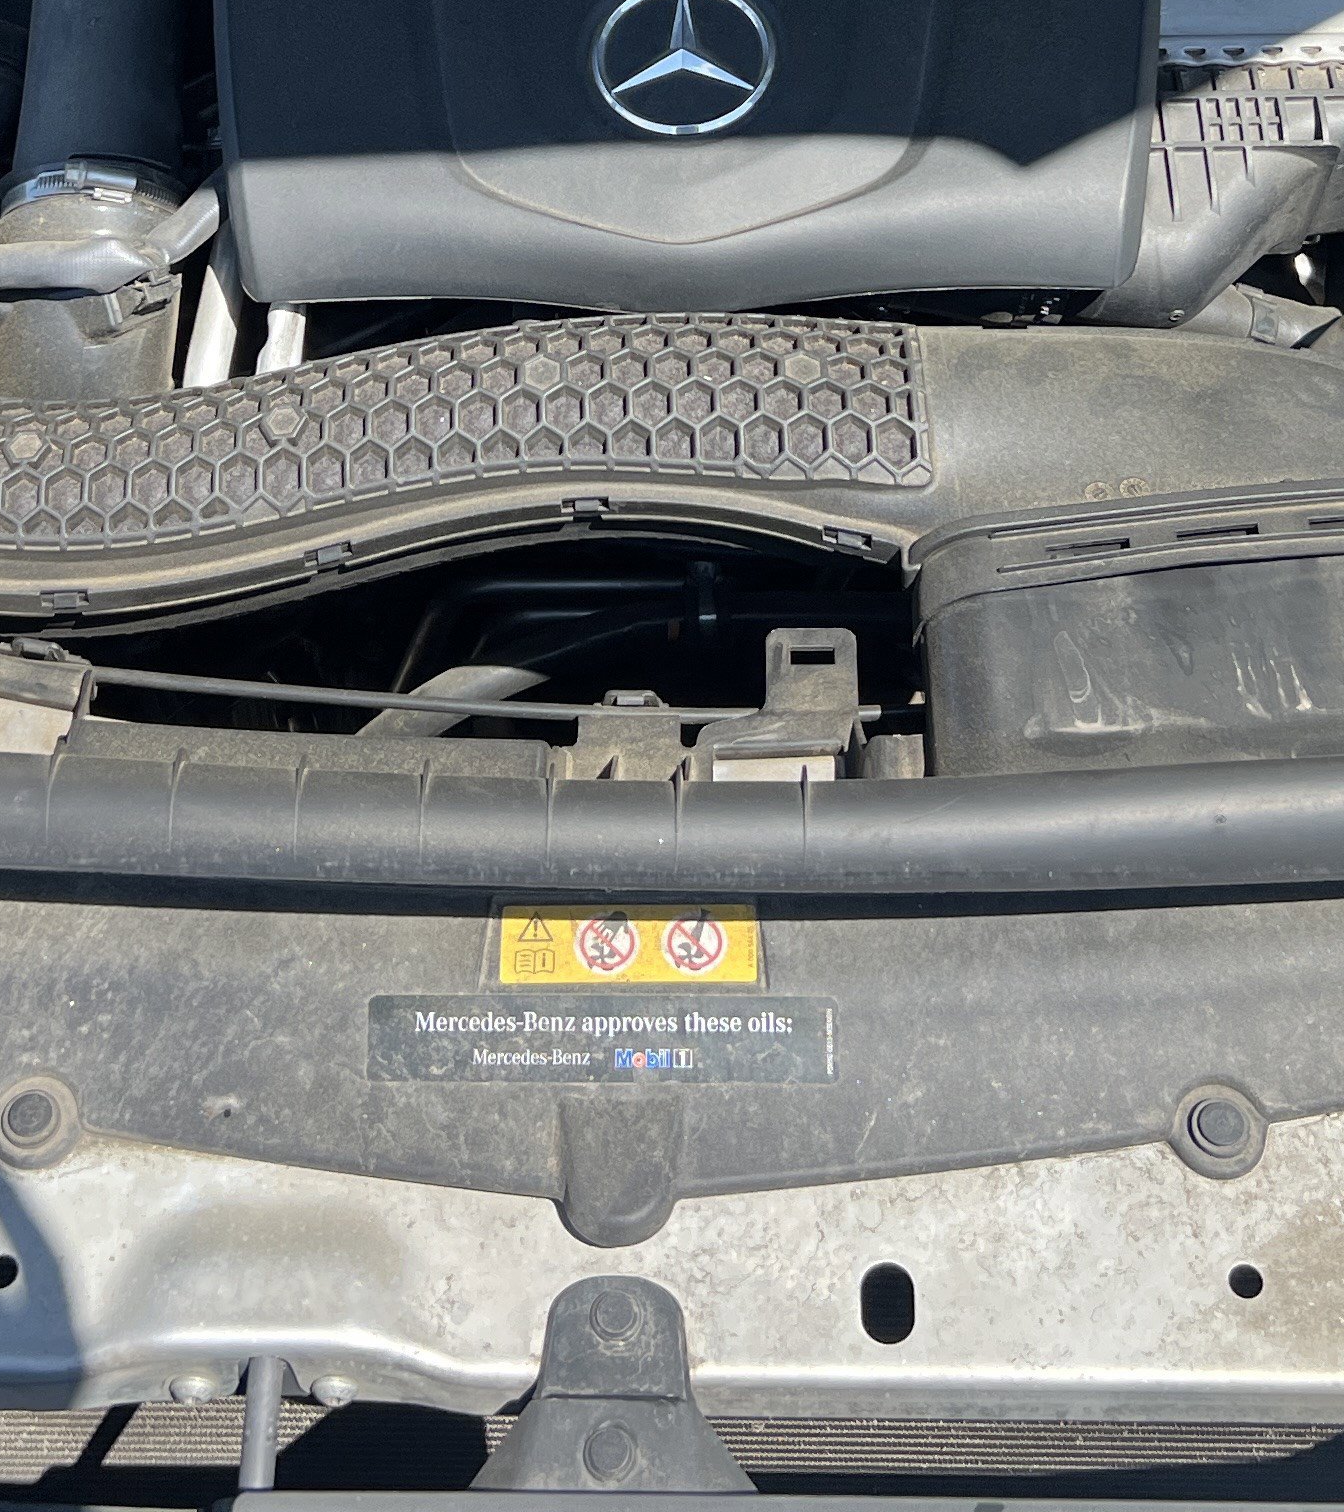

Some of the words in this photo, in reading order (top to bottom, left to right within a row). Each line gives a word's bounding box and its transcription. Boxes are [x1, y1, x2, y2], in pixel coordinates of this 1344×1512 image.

[414, 1011, 576, 1033] Mercedes-Benz
[581, 1015, 678, 1037] approves
[684, 1011, 742, 1033] these
[747, 1011, 794, 1033] oils:
[472, 1048, 591, 1066] Mercedes-Benz
[614, 1047, 671, 1069] Mobil
